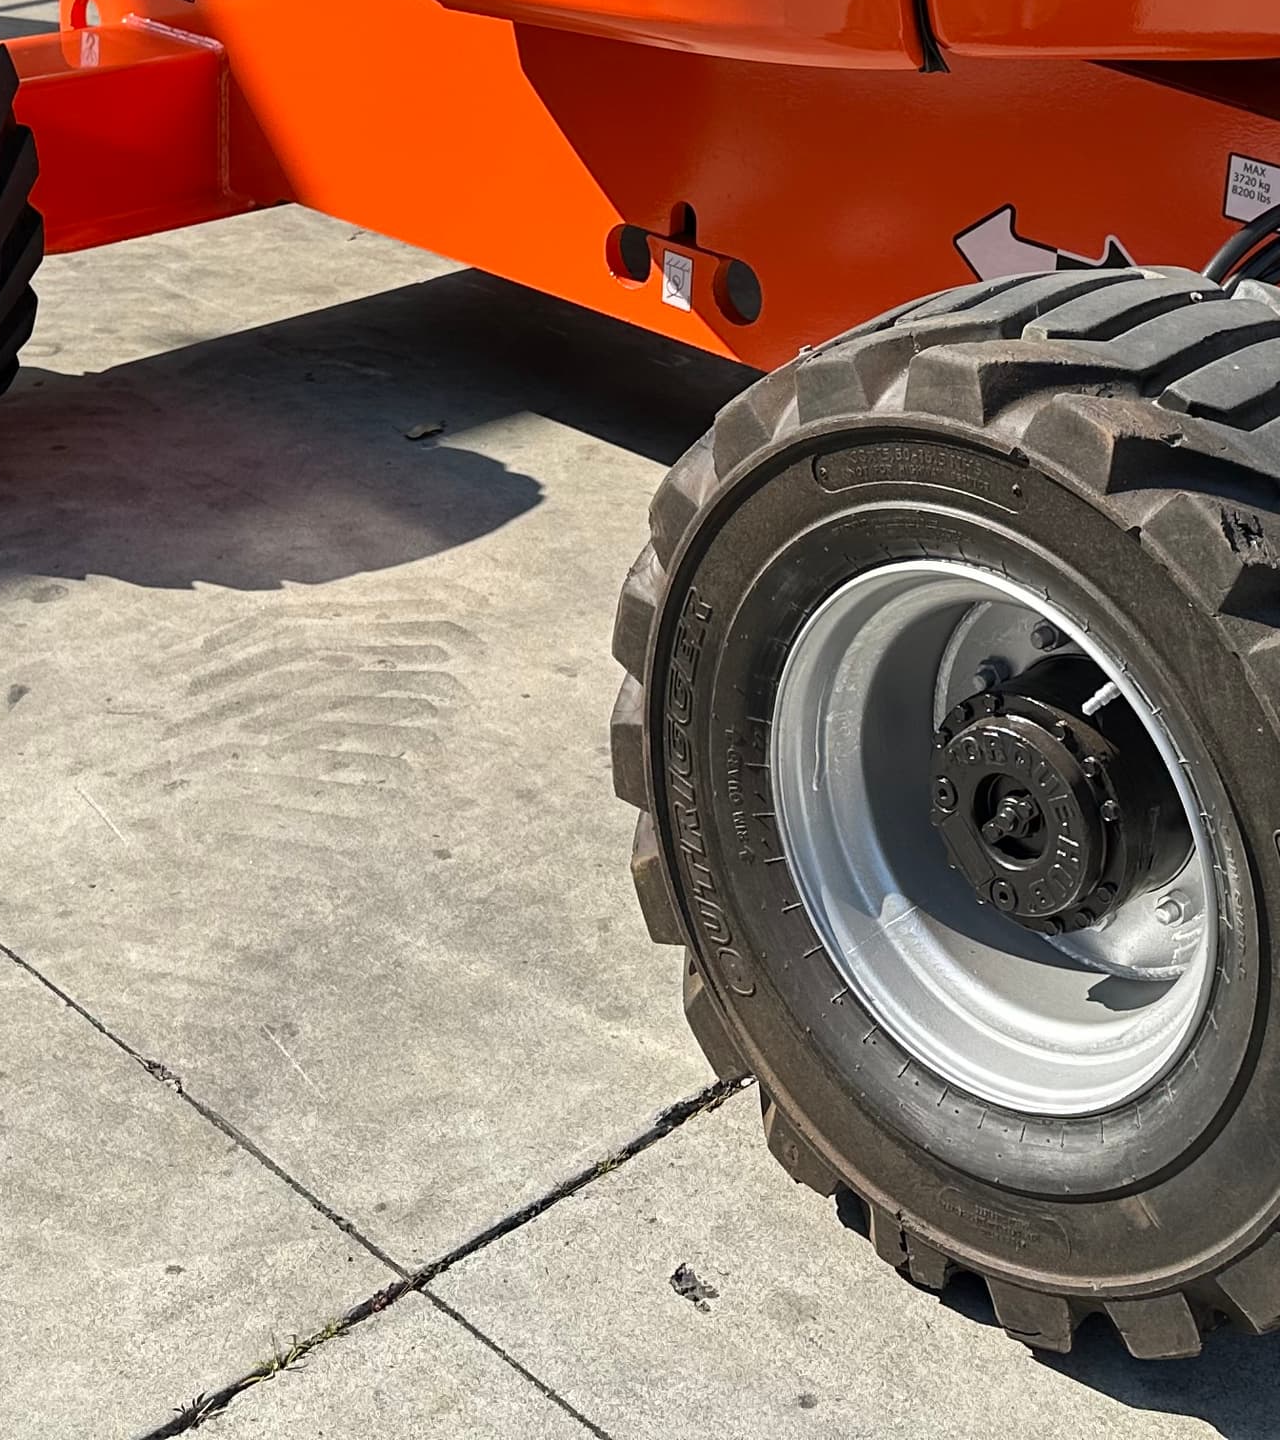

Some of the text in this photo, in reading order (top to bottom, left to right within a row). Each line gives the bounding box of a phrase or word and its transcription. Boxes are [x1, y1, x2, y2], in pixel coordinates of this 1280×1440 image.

[1243, 162, 1266, 178] MAX
[1233, 171, 1271, 194] 3720 kg
[1231, 184, 1272, 205] 8200 lbs
[664, 585, 756, 997] OUTRIGGER
